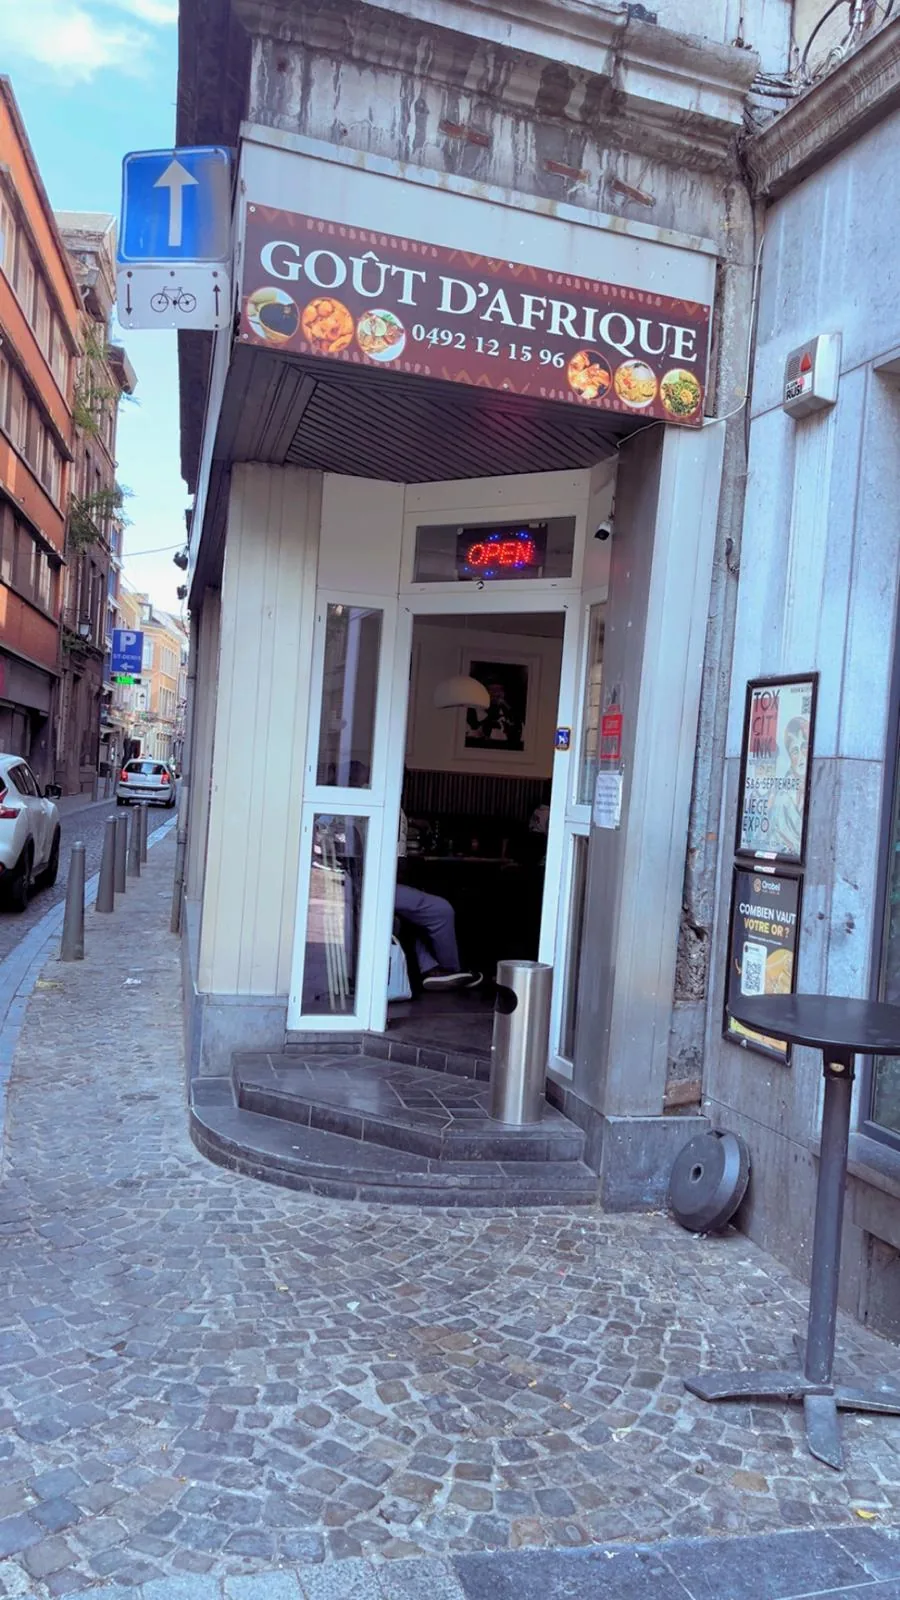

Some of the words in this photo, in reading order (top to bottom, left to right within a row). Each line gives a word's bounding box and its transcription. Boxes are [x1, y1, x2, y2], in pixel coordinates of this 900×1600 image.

[260, 240, 427, 306] GOÛT
[436, 276, 698, 363] D’AFRIQUE
[411, 323, 466, 350] 0492
[475, 336, 500, 356] 12
[508, 343, 532, 362] 15
[539, 349, 565, 368] 96
[468, 541, 533, 565] OPEN
[120, 632, 137, 652] P
[754, 689, 780, 712] TOX
[752, 736, 772, 759] INK
[743, 815, 769, 833] EXPO
[739, 902, 775, 920] COMBIEN
[776, 909, 796, 925] VAUT
[744, 917, 769, 934] VOTRE
[771, 924, 783, 936] OR
